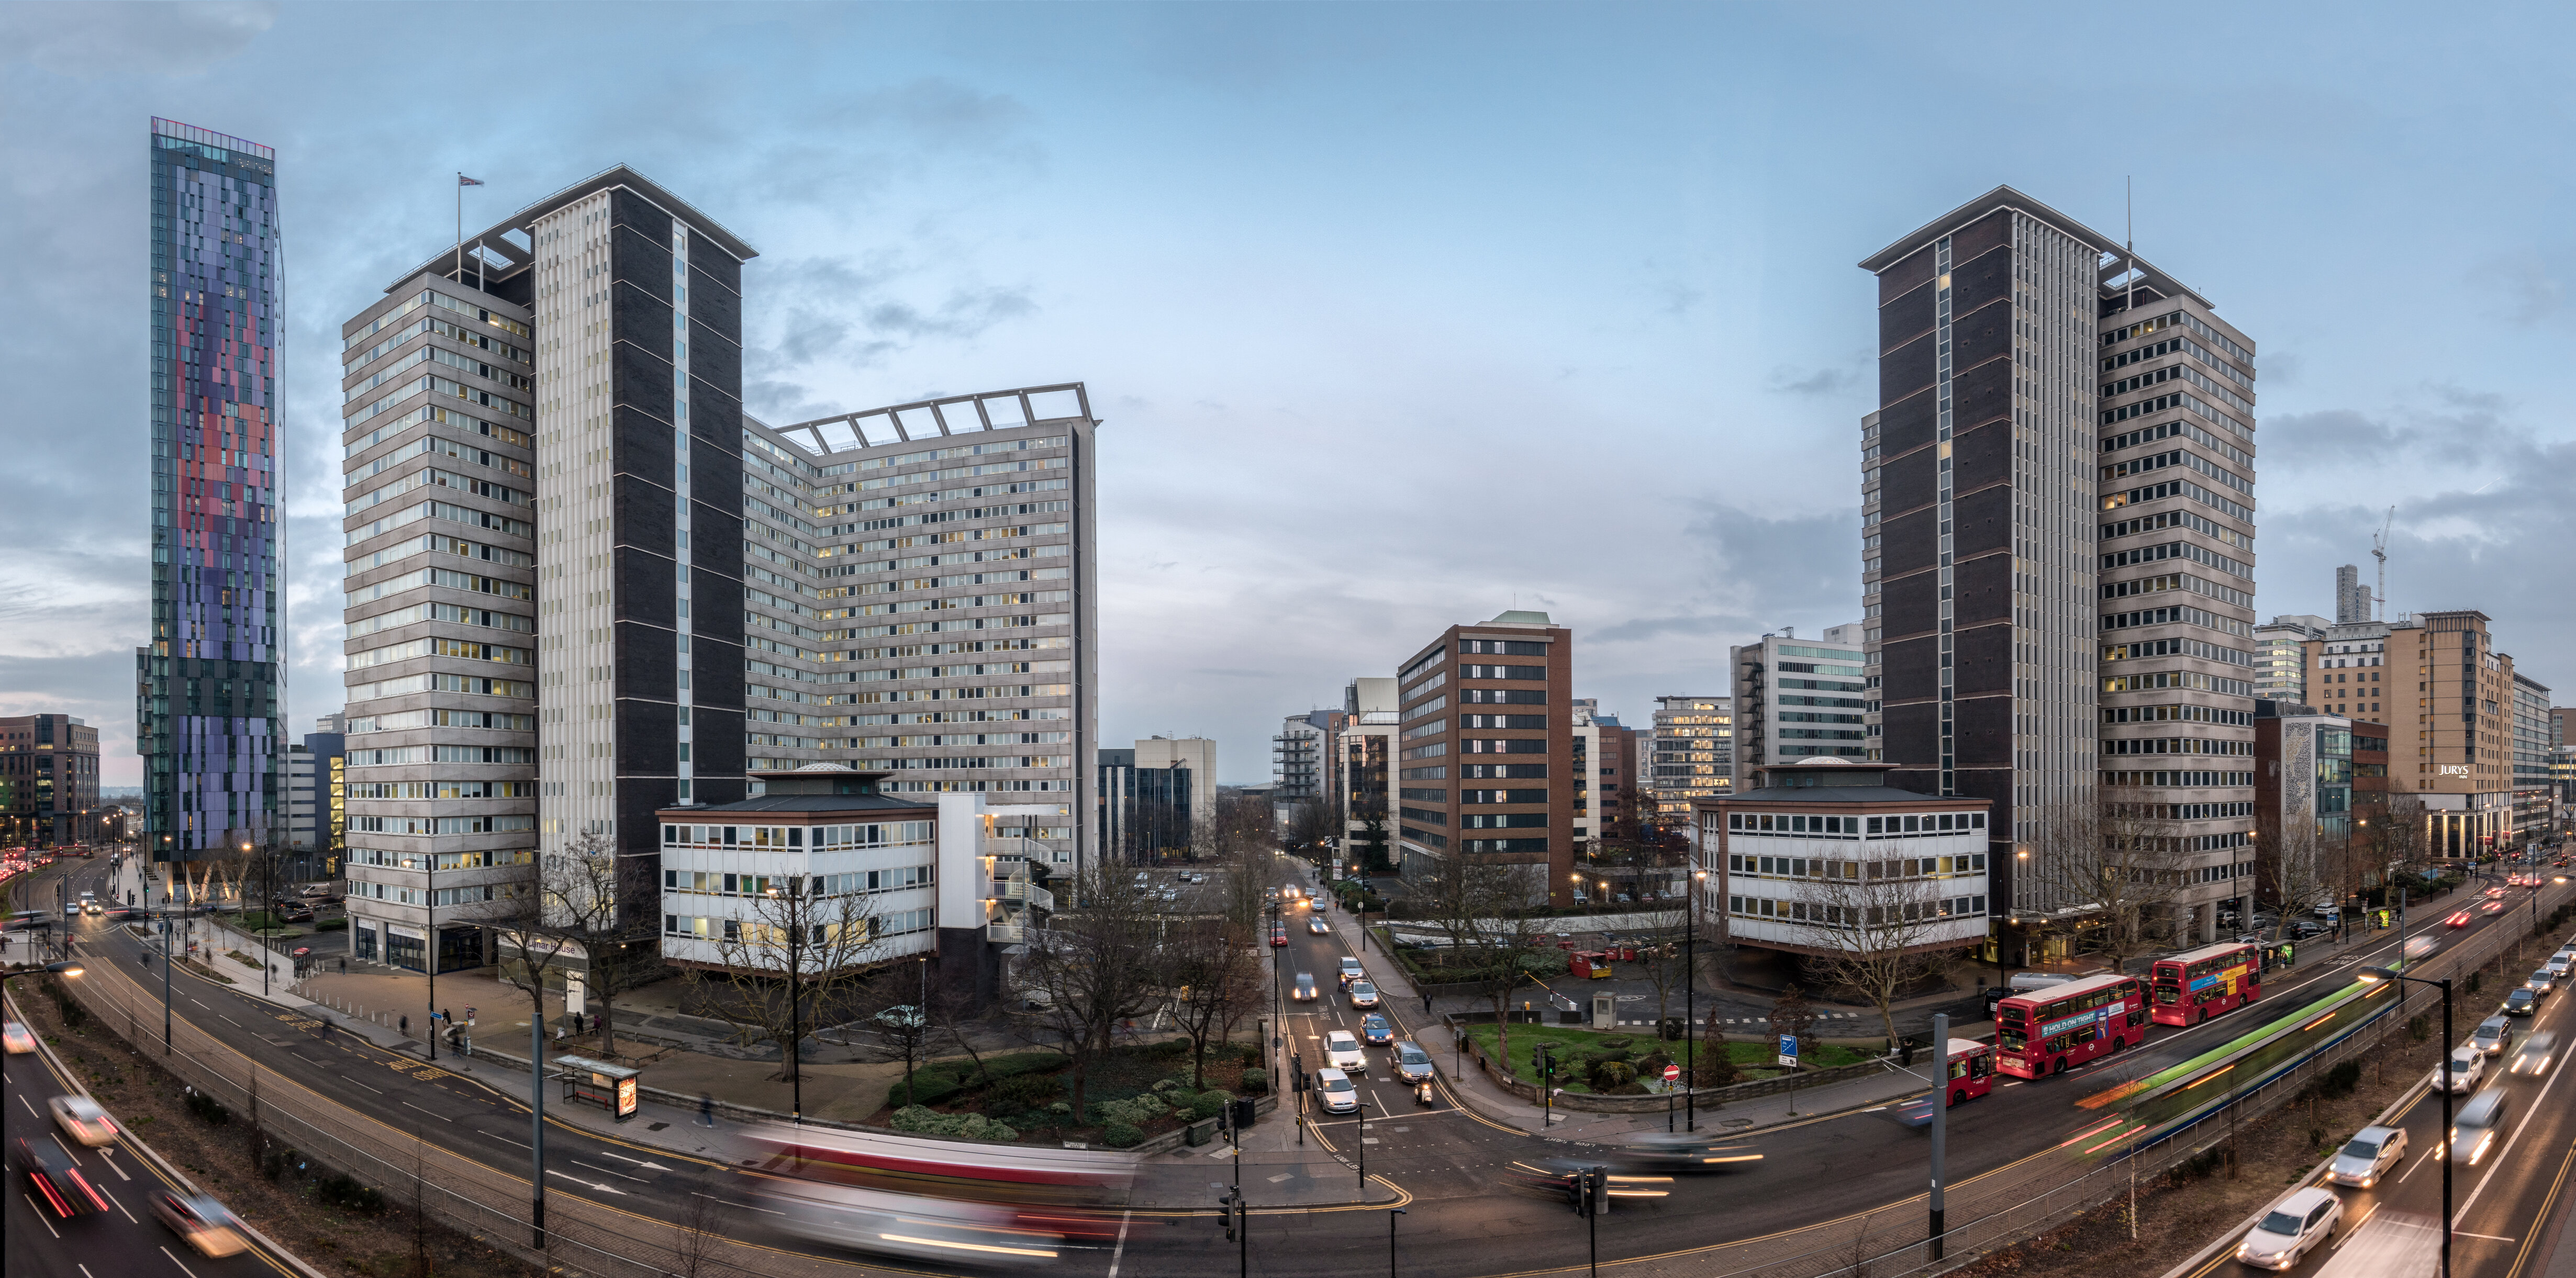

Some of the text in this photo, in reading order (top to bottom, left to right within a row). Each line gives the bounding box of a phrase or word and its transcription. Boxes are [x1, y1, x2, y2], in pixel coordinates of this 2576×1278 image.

[2439, 765, 2468, 775] JURYS
[528, 939, 549, 950] Lunar
[2049, 1013, 2094, 1033] HOLD ON TIGHT
[412, 1069, 449, 1080] BUS
[620, 1085, 634, 1098] GRAVY
[1334, 1154, 1350, 1163] LOOK
